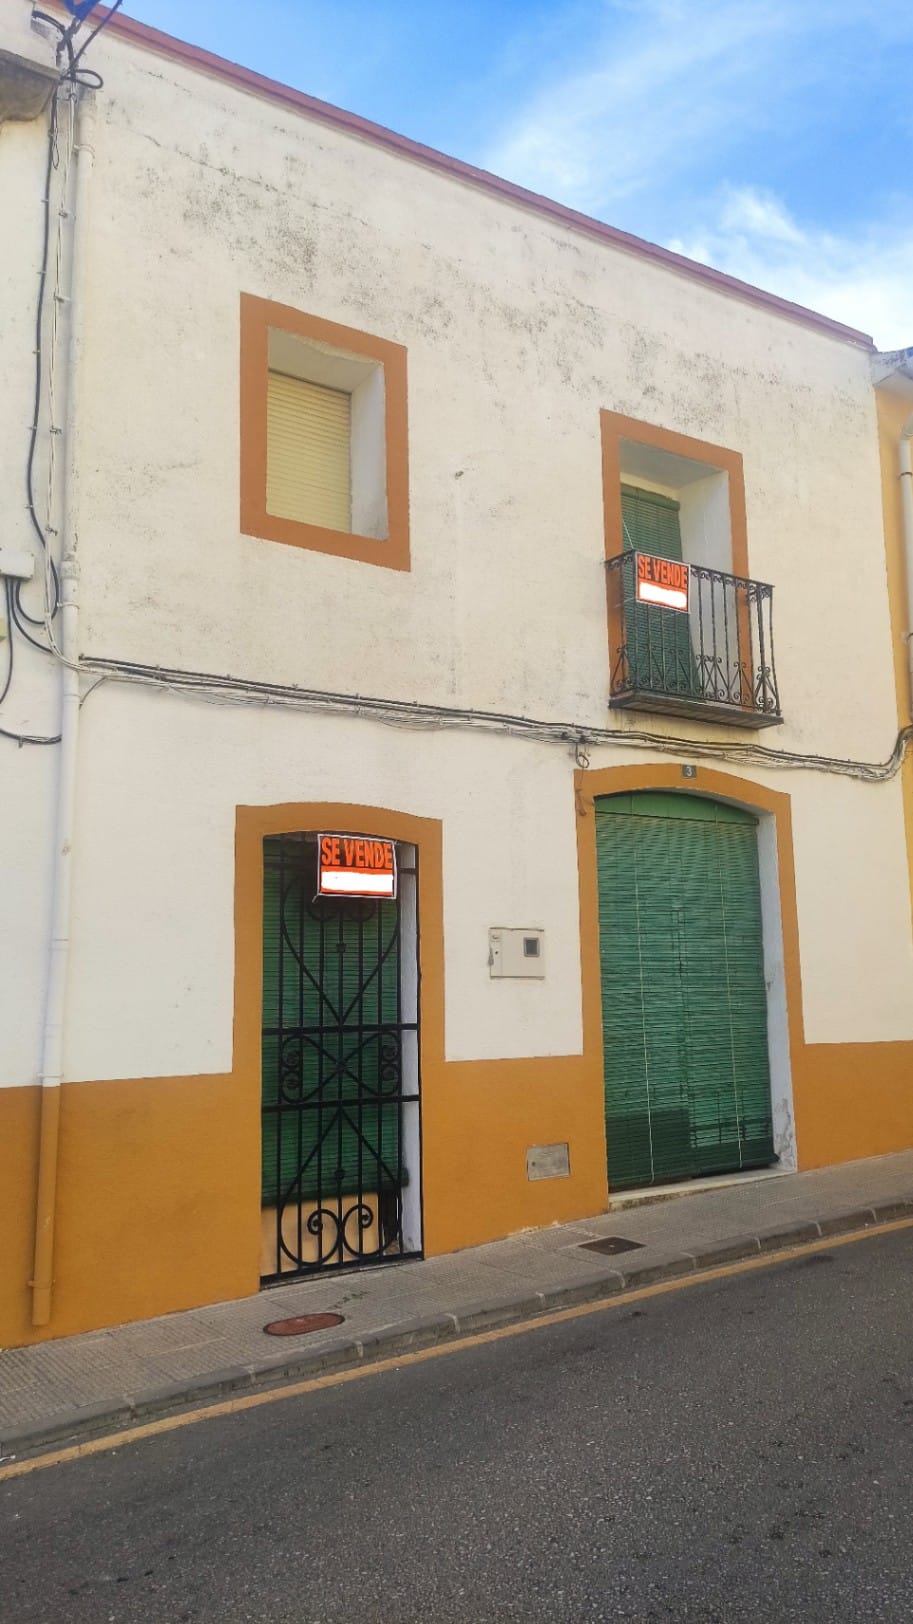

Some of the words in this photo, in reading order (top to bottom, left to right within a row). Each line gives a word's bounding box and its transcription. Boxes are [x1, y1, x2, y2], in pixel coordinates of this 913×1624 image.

[638, 555, 651, 580] SE
[653, 559, 688, 589] VENDE
[686, 766, 693, 777] 3
[321, 837, 340, 865] SE
[343, 839, 393, 869] VENDE
